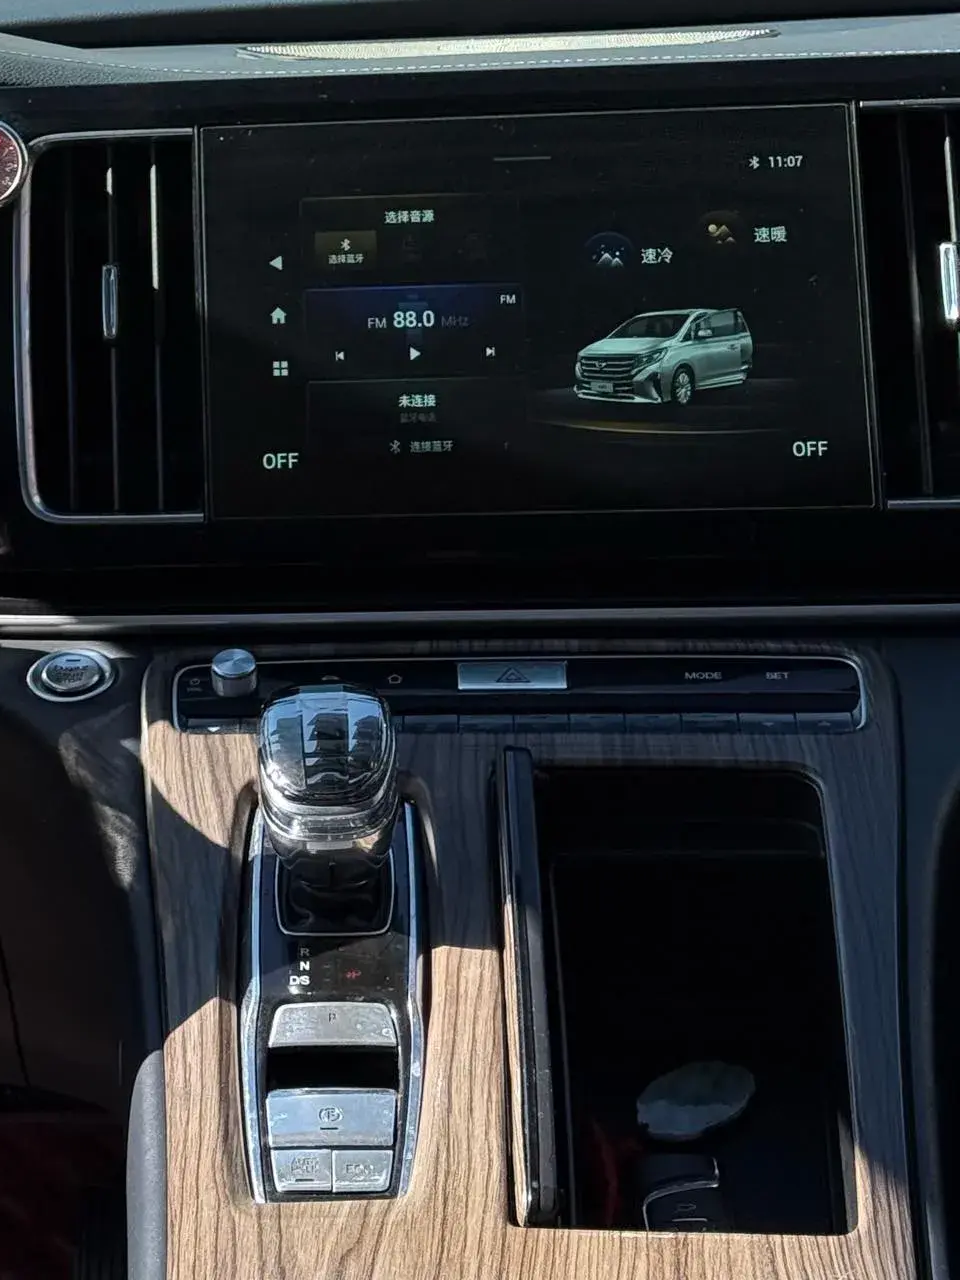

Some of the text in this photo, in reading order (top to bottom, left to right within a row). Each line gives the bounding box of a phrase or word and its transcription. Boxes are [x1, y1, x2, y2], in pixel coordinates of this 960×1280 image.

[768, 155, 803, 168] 11:07
[384, 209, 435, 224] 选择音源
[753, 225, 788, 243] 速暖
[640, 247, 674, 265] 速冷
[499, 294, 516, 305] FM
[367, 317, 387, 329] FM
[392, 310, 435, 329] 88.0
[398, 394, 437, 408] 未连接
[409, 440, 454, 453] 连接蓝牙
[792, 440, 829, 457] OFF
[262, 452, 299, 469] OFF
[684, 671, 722, 680] MODE
[765, 671, 789, 680] SET
[299, 961, 311, 971] N
